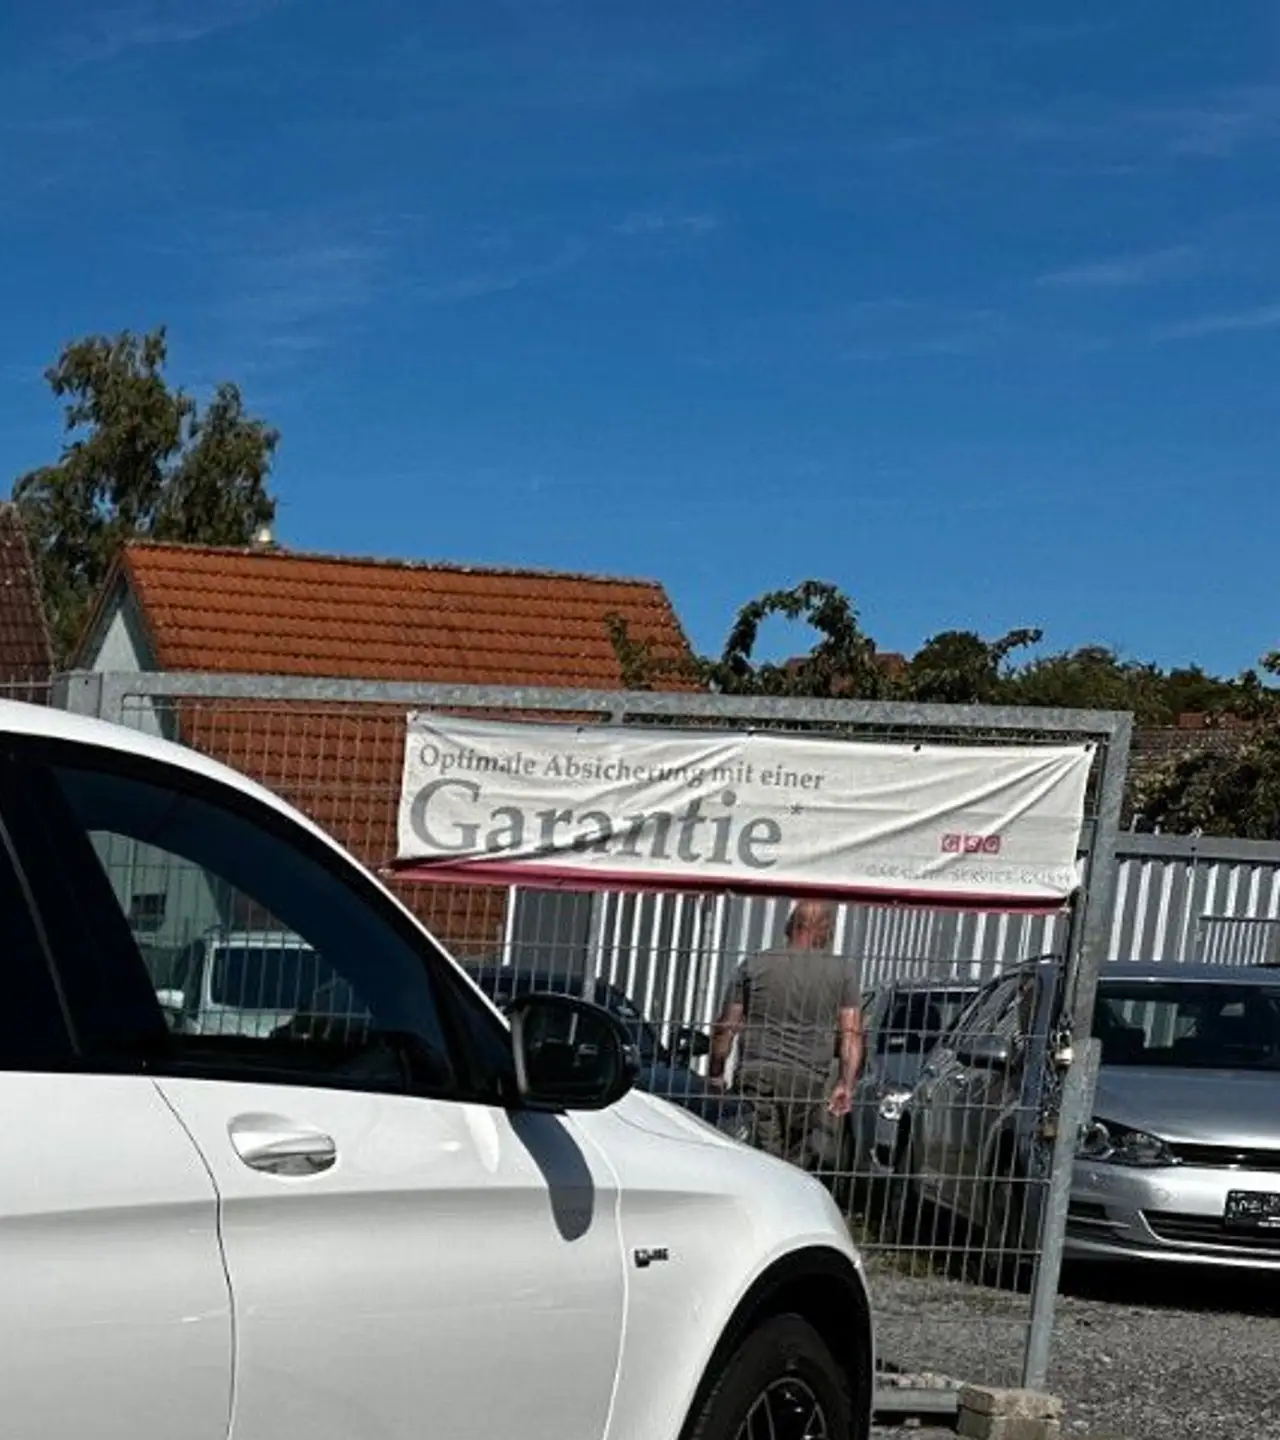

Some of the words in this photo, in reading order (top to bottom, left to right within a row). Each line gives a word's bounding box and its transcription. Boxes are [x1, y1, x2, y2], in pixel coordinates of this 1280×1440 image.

[420, 746, 537, 776] Optimale
[543, 754, 706, 787] Absicherung
[712, 761, 754, 783] mit
[759, 764, 826, 790] einer
